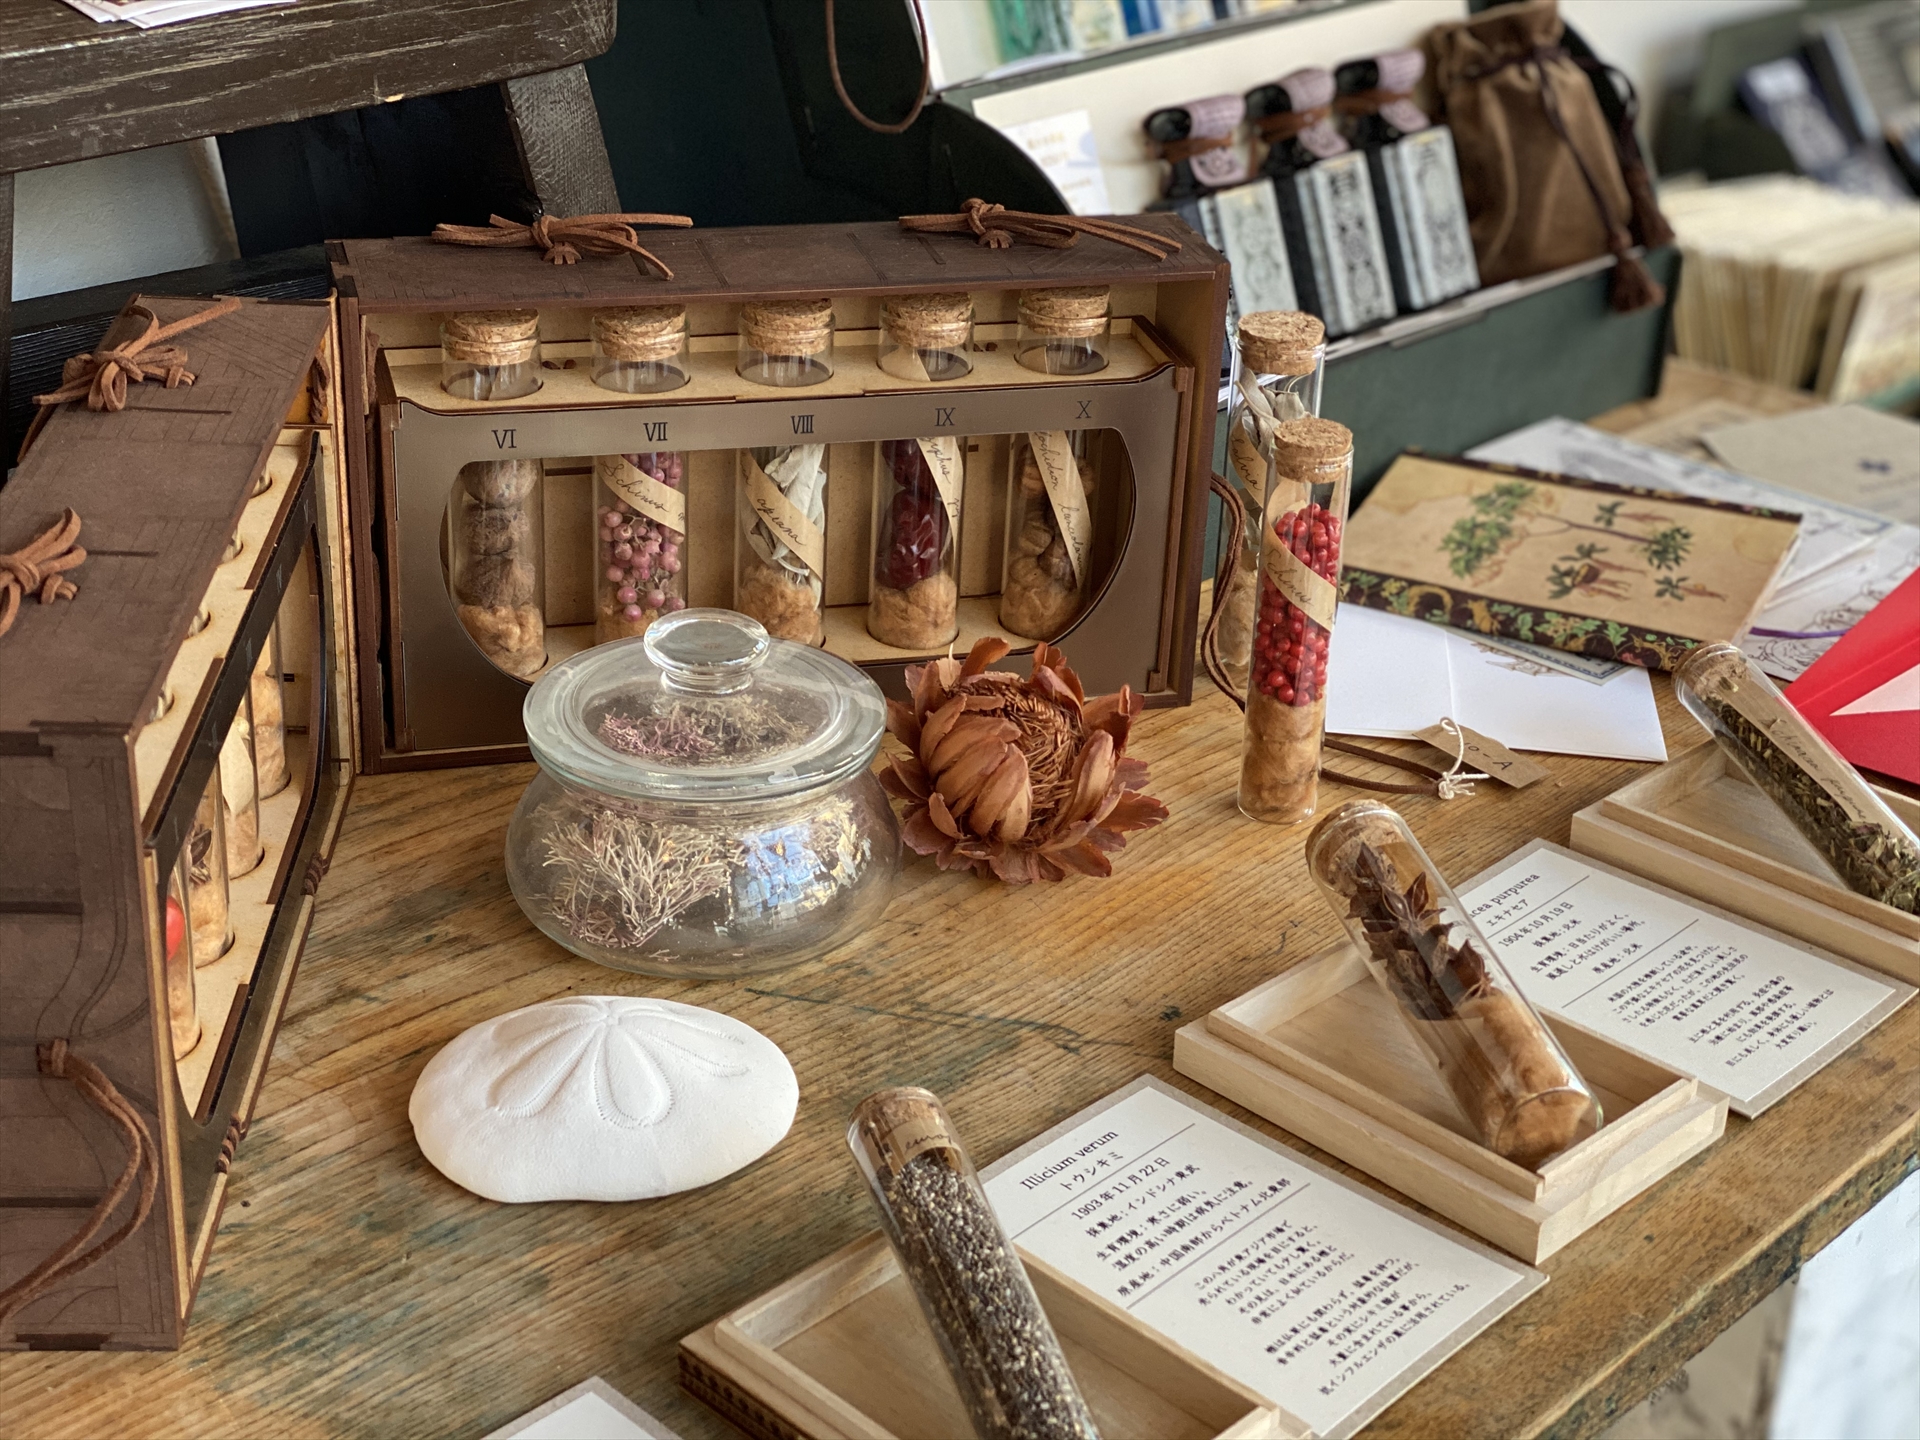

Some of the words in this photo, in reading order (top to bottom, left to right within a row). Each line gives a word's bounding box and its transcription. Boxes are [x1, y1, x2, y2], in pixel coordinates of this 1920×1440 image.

[790, 414, 816, 435] VIII
[934, 407, 957, 428] IX
[1076, 400, 1093, 420] X
[491, 429, 518, 450] VI
[643, 421, 669, 443] VII
[1489, 873, 1541, 906] purpurea
[1485, 898, 1529, 927] エキナセア
[1019, 1156, 1079, 1191] Illicium
[1074, 1131, 1120, 1157] verum
[1059, 1151, 1124, 1191] トウシキミ
[1111, 1180, 1254, 1272] 湿度の高い時期は病気に注意。
[1194, 1218, 1293, 1290] この八角が東アジア市場で
